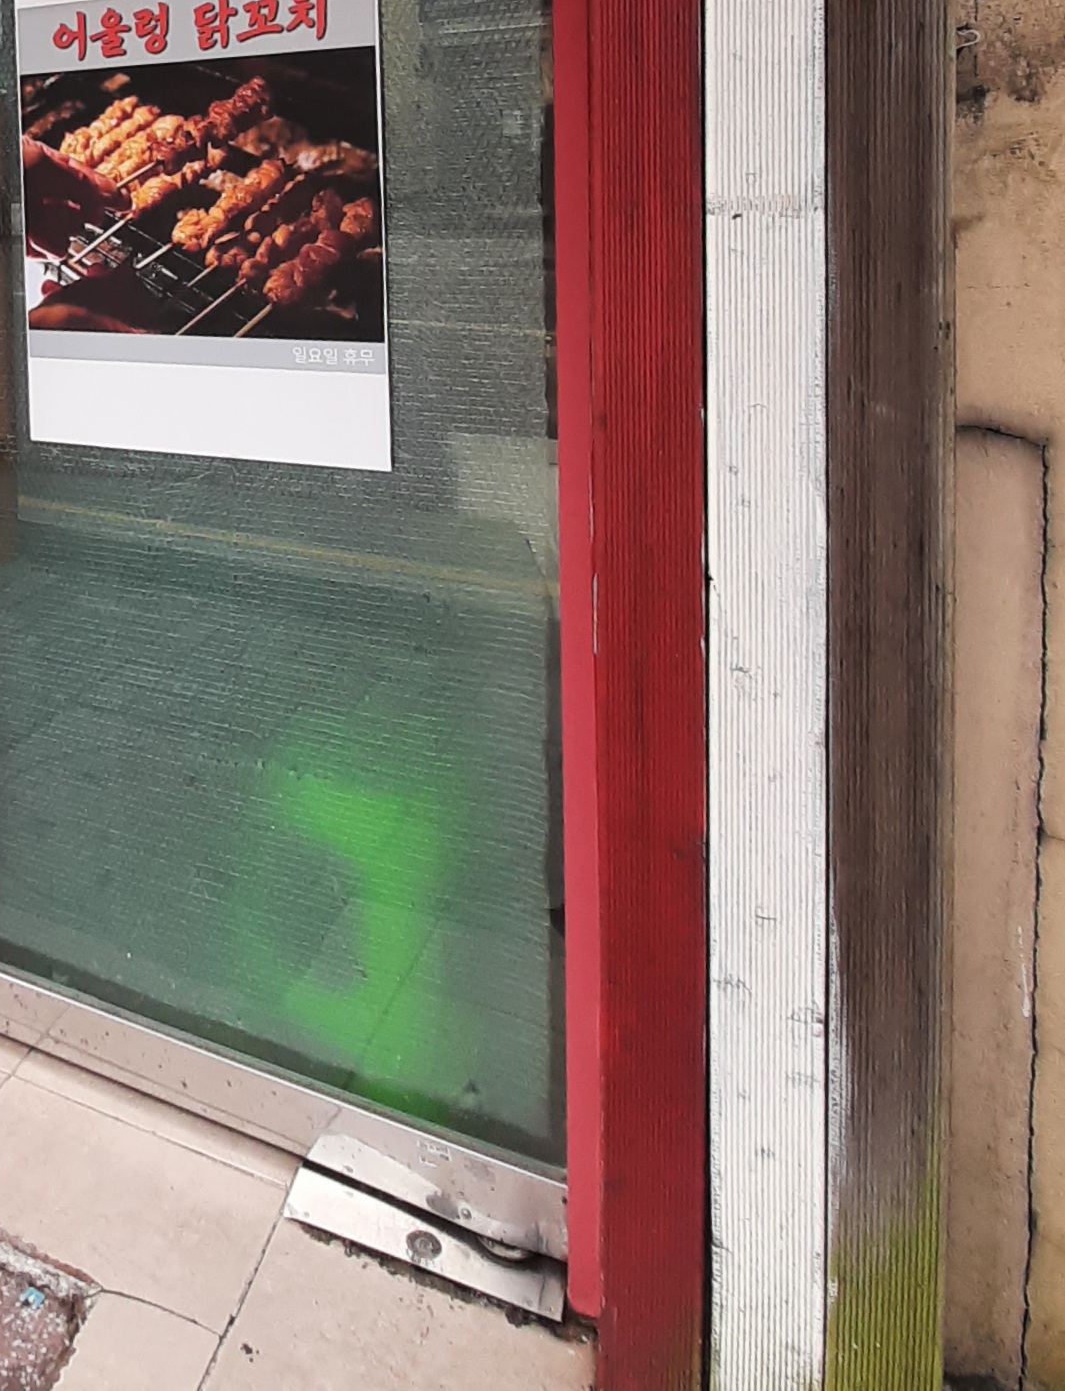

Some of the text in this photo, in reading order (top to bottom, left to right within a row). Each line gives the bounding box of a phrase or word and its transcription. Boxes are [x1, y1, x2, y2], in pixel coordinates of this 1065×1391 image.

[53, 2, 169, 61] 어울렁
[292, 346, 375, 366] 일요일 휴무
